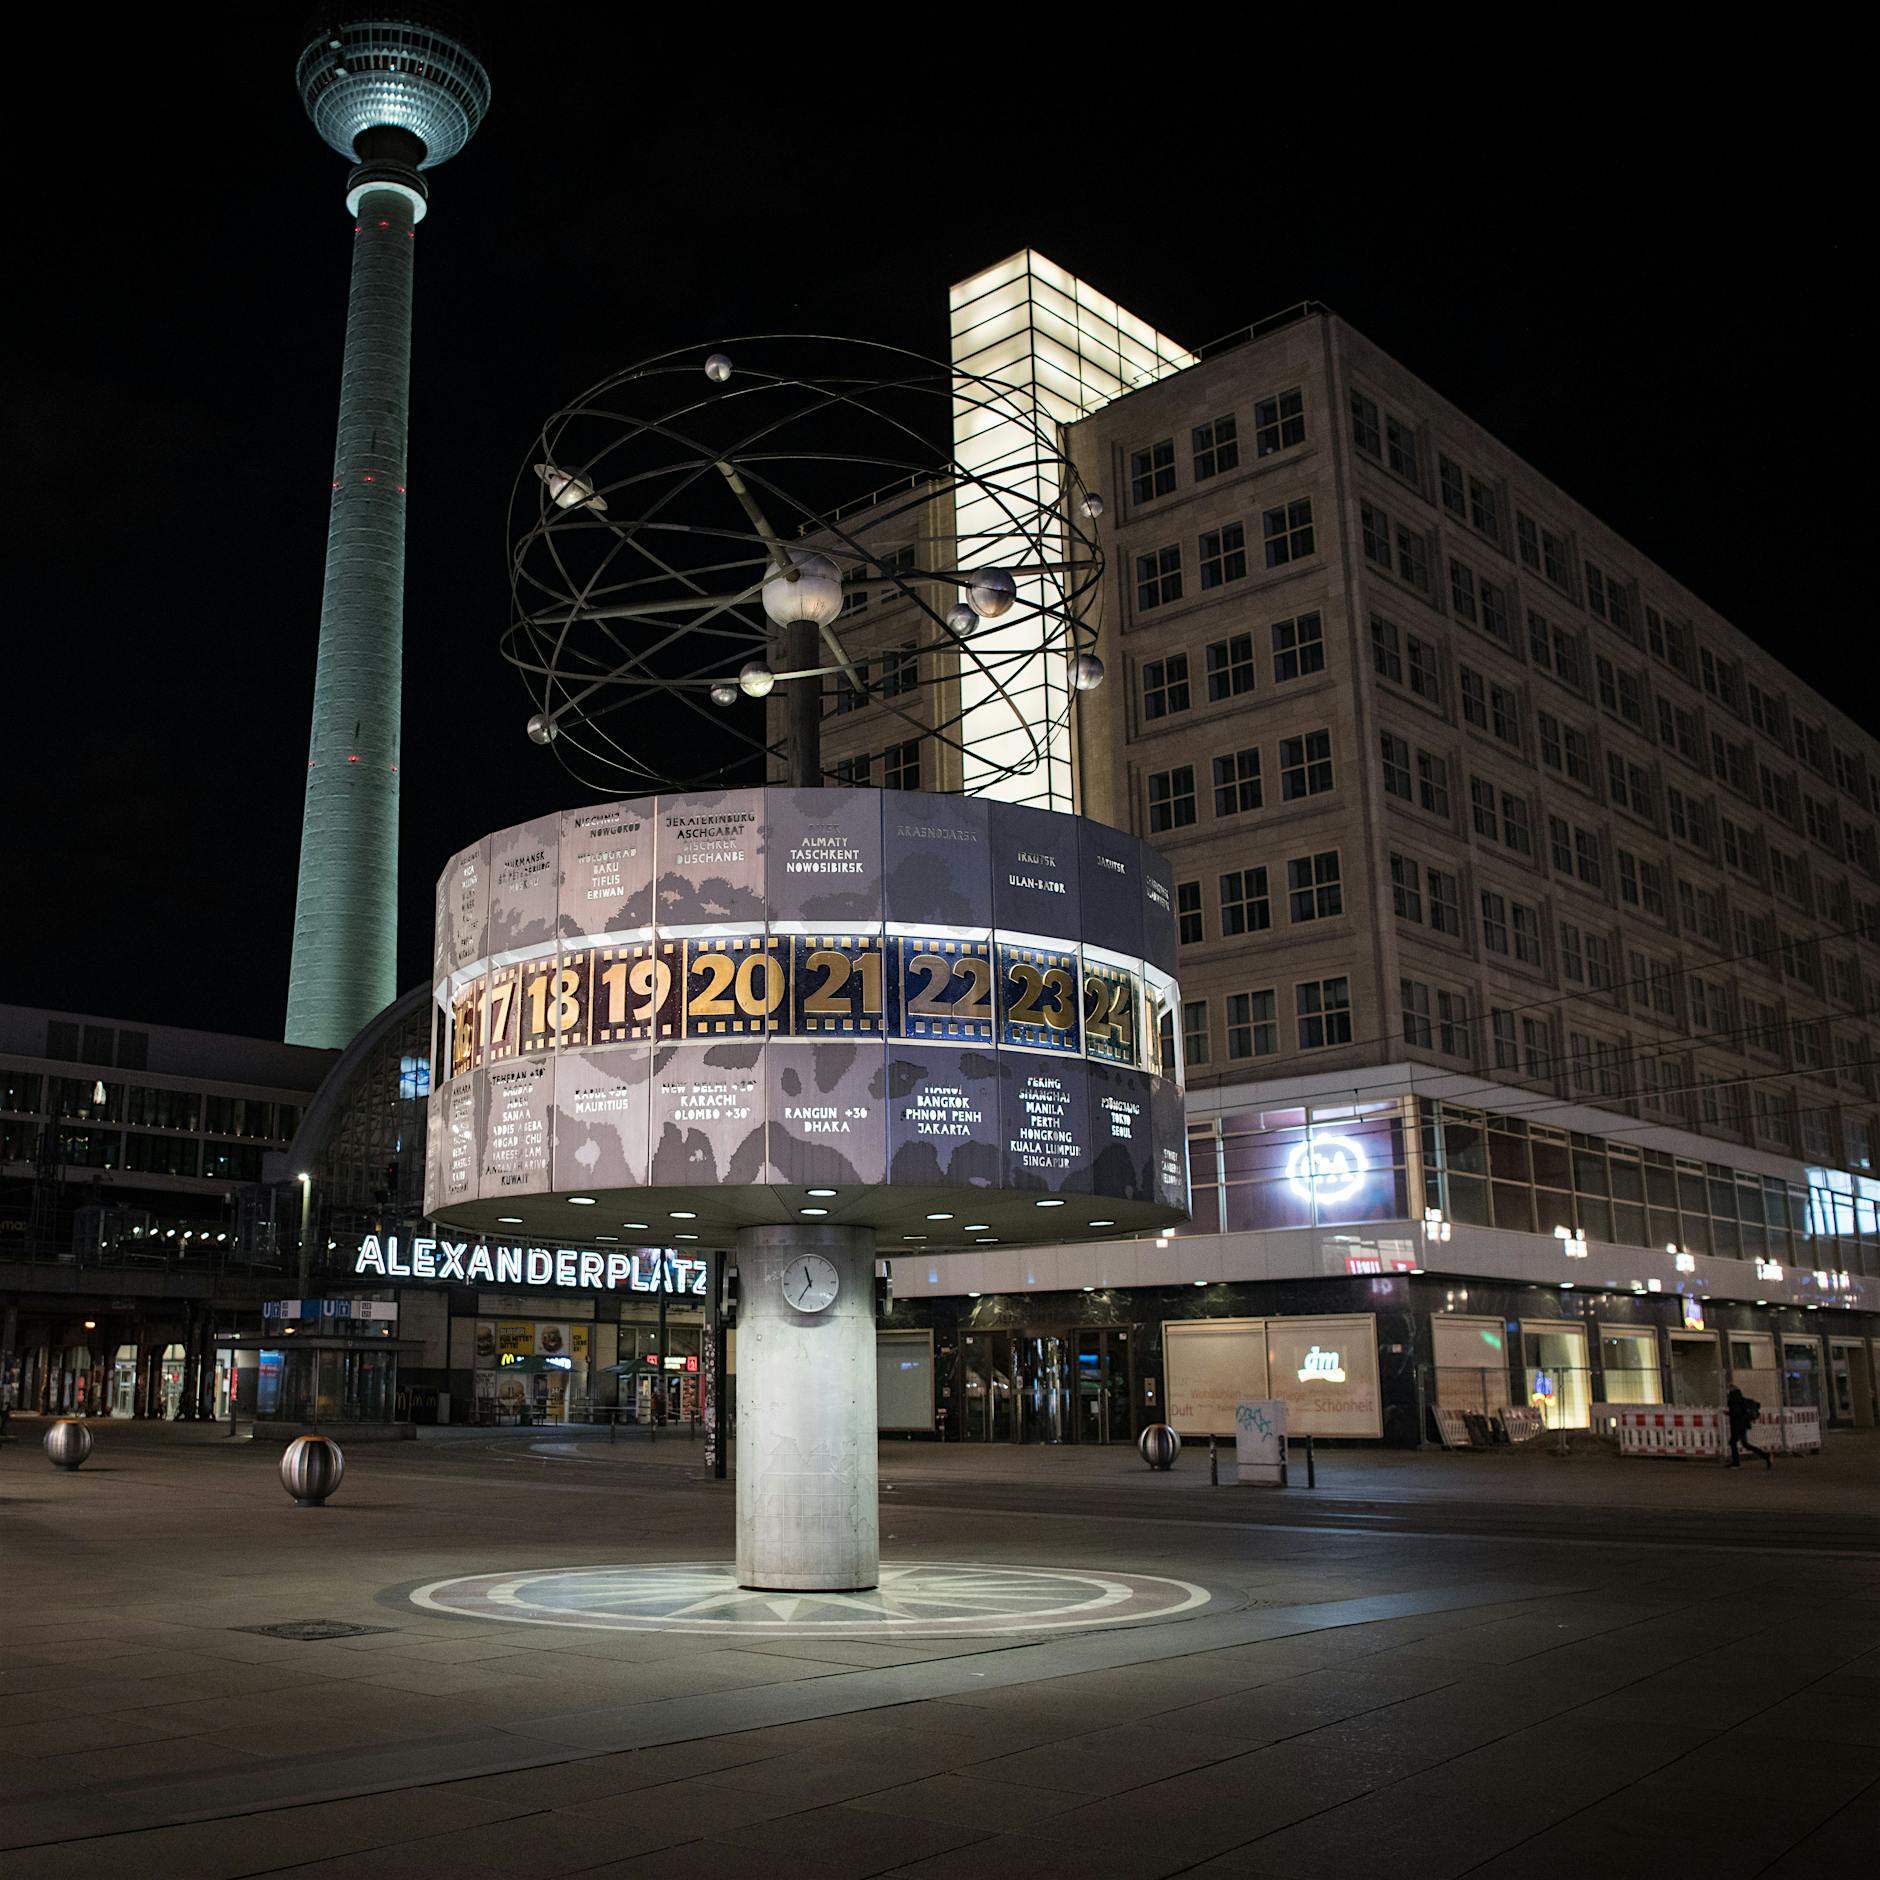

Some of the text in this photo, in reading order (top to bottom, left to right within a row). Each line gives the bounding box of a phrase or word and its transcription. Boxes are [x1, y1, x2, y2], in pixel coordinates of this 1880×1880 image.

[666, 812, 755, 827] JEKATERINBURG
[590, 822, 640, 838] NOWGOROD
[677, 825, 745, 839] ASCHGABAT
[802, 837, 848, 847] ALMATY
[676, 852, 745, 865] DUSCHANBE
[790, 850, 859, 860] TASCHKENT
[1017, 851, 1056, 868] IRKUTSK
[593, 864, 619, 875] BAKU
[787, 862, 864, 873] NOWOSIBIRSK
[592, 876, 620, 887] TIFLIS
[1009, 875, 1066, 894] ULAN-BATOR
[587, 887, 624, 899] ERIWAN
[477, 981, 516, 1048] 17
[527, 970, 580, 1035] 18
[602, 959, 672, 1024] 19
[689, 954, 785, 1016] 20
[804, 951, 882, 1013] 21
[908, 955, 992, 1018] 22
[1008, 964, 1074, 1030] 23
[1085, 978, 1132, 1045] 24
[661, 1081, 687, 1094] NEW
[692, 1080, 727, 1093] DELHI
[1027, 1076, 1061, 1089] PEKING
[574, 1088, 605, 1101] KABUL
[680, 1095, 736, 1107] KARACHI
[1018, 1088, 1071, 1103] SHANGHAI
[576, 1100, 629, 1114] MAURITIUS
[917, 1096, 970, 1108] BANGKOK
[503, 1109, 531, 1122] SANAA
[666, 1108, 720, 1121] OLOMBO
[785, 1107, 837, 1119] RANGUN
[905, 1108, 982, 1123] PHNOM PENH
[1025, 1102, 1064, 1116] MANILA
[1031, 1115, 1060, 1128] PERTH
[1111, 1112, 1131, 1126] TOKYO
[804, 1121, 850, 1132] DHAKA
[917, 1122, 970, 1135] JAKARTA
[1112, 1125, 1132, 1139] SEOUL
[1020, 1128, 1072, 1143] HONGKONG
[1010, 1140, 1081, 1157] KUALA LUMPUR
[1023, 1155, 1070, 1168] SINGAPUR
[501, 1175, 528, 1185] KUWAIT
[354, 1234, 708, 1295] ALEXANDERPLATZ
[323, 1300, 334, 1316] U
[1304, 1346, 1339, 1369] dm
[1314, 1398, 1375, 1412] Schönheit
